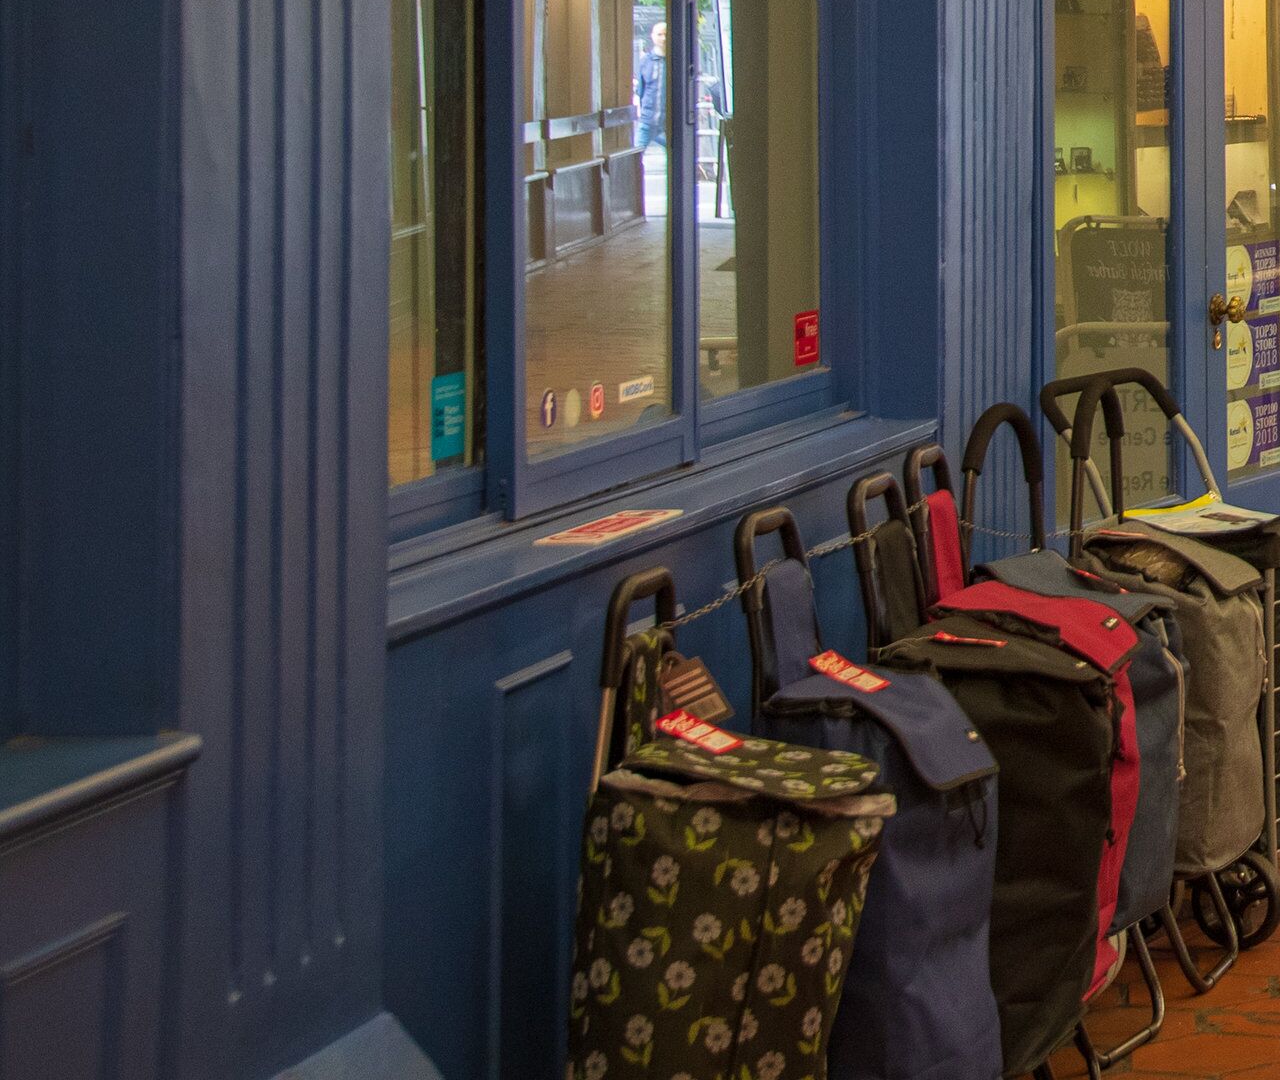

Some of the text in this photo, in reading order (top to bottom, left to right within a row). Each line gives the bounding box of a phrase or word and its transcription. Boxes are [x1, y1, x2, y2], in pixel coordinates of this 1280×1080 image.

[1256, 280, 1276, 296] 2018
[1254, 322, 1278, 339] TOP30
[1255, 336, 1278, 352] STORE
[1254, 349, 1278, 369] 2018
[1254, 401, 1279, 418] TOP100
[1255, 413, 1278, 431] STORE
[1255, 425, 1278, 446] 2018
